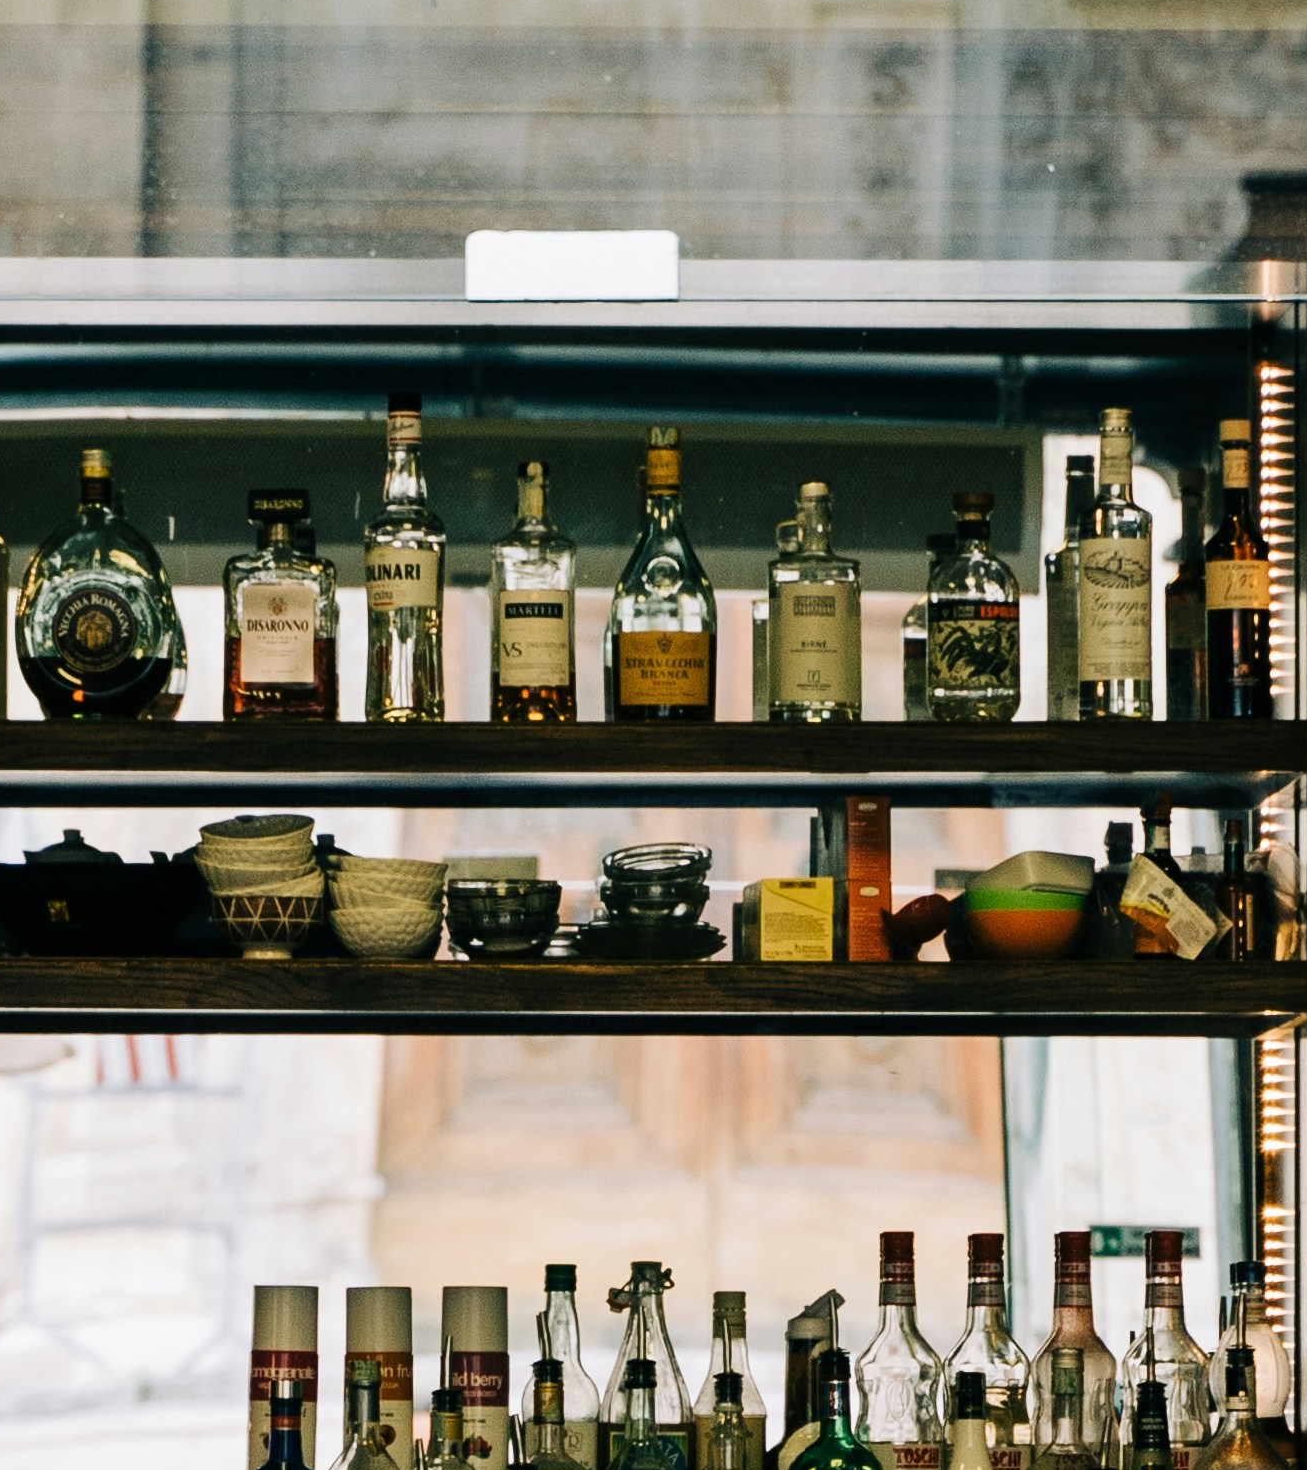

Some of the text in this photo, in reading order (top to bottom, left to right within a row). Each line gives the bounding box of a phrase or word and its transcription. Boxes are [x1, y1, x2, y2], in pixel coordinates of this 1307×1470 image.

[91, 592, 130, 638] ROMAGNA
[246, 618, 309, 634] DISARONNO
[502, 641, 523, 659] VS
[470, 1371, 502, 1390] berry
[893, 1448, 940, 1466] TOSCHI
[992, 1449, 1022, 1467] SCHI
